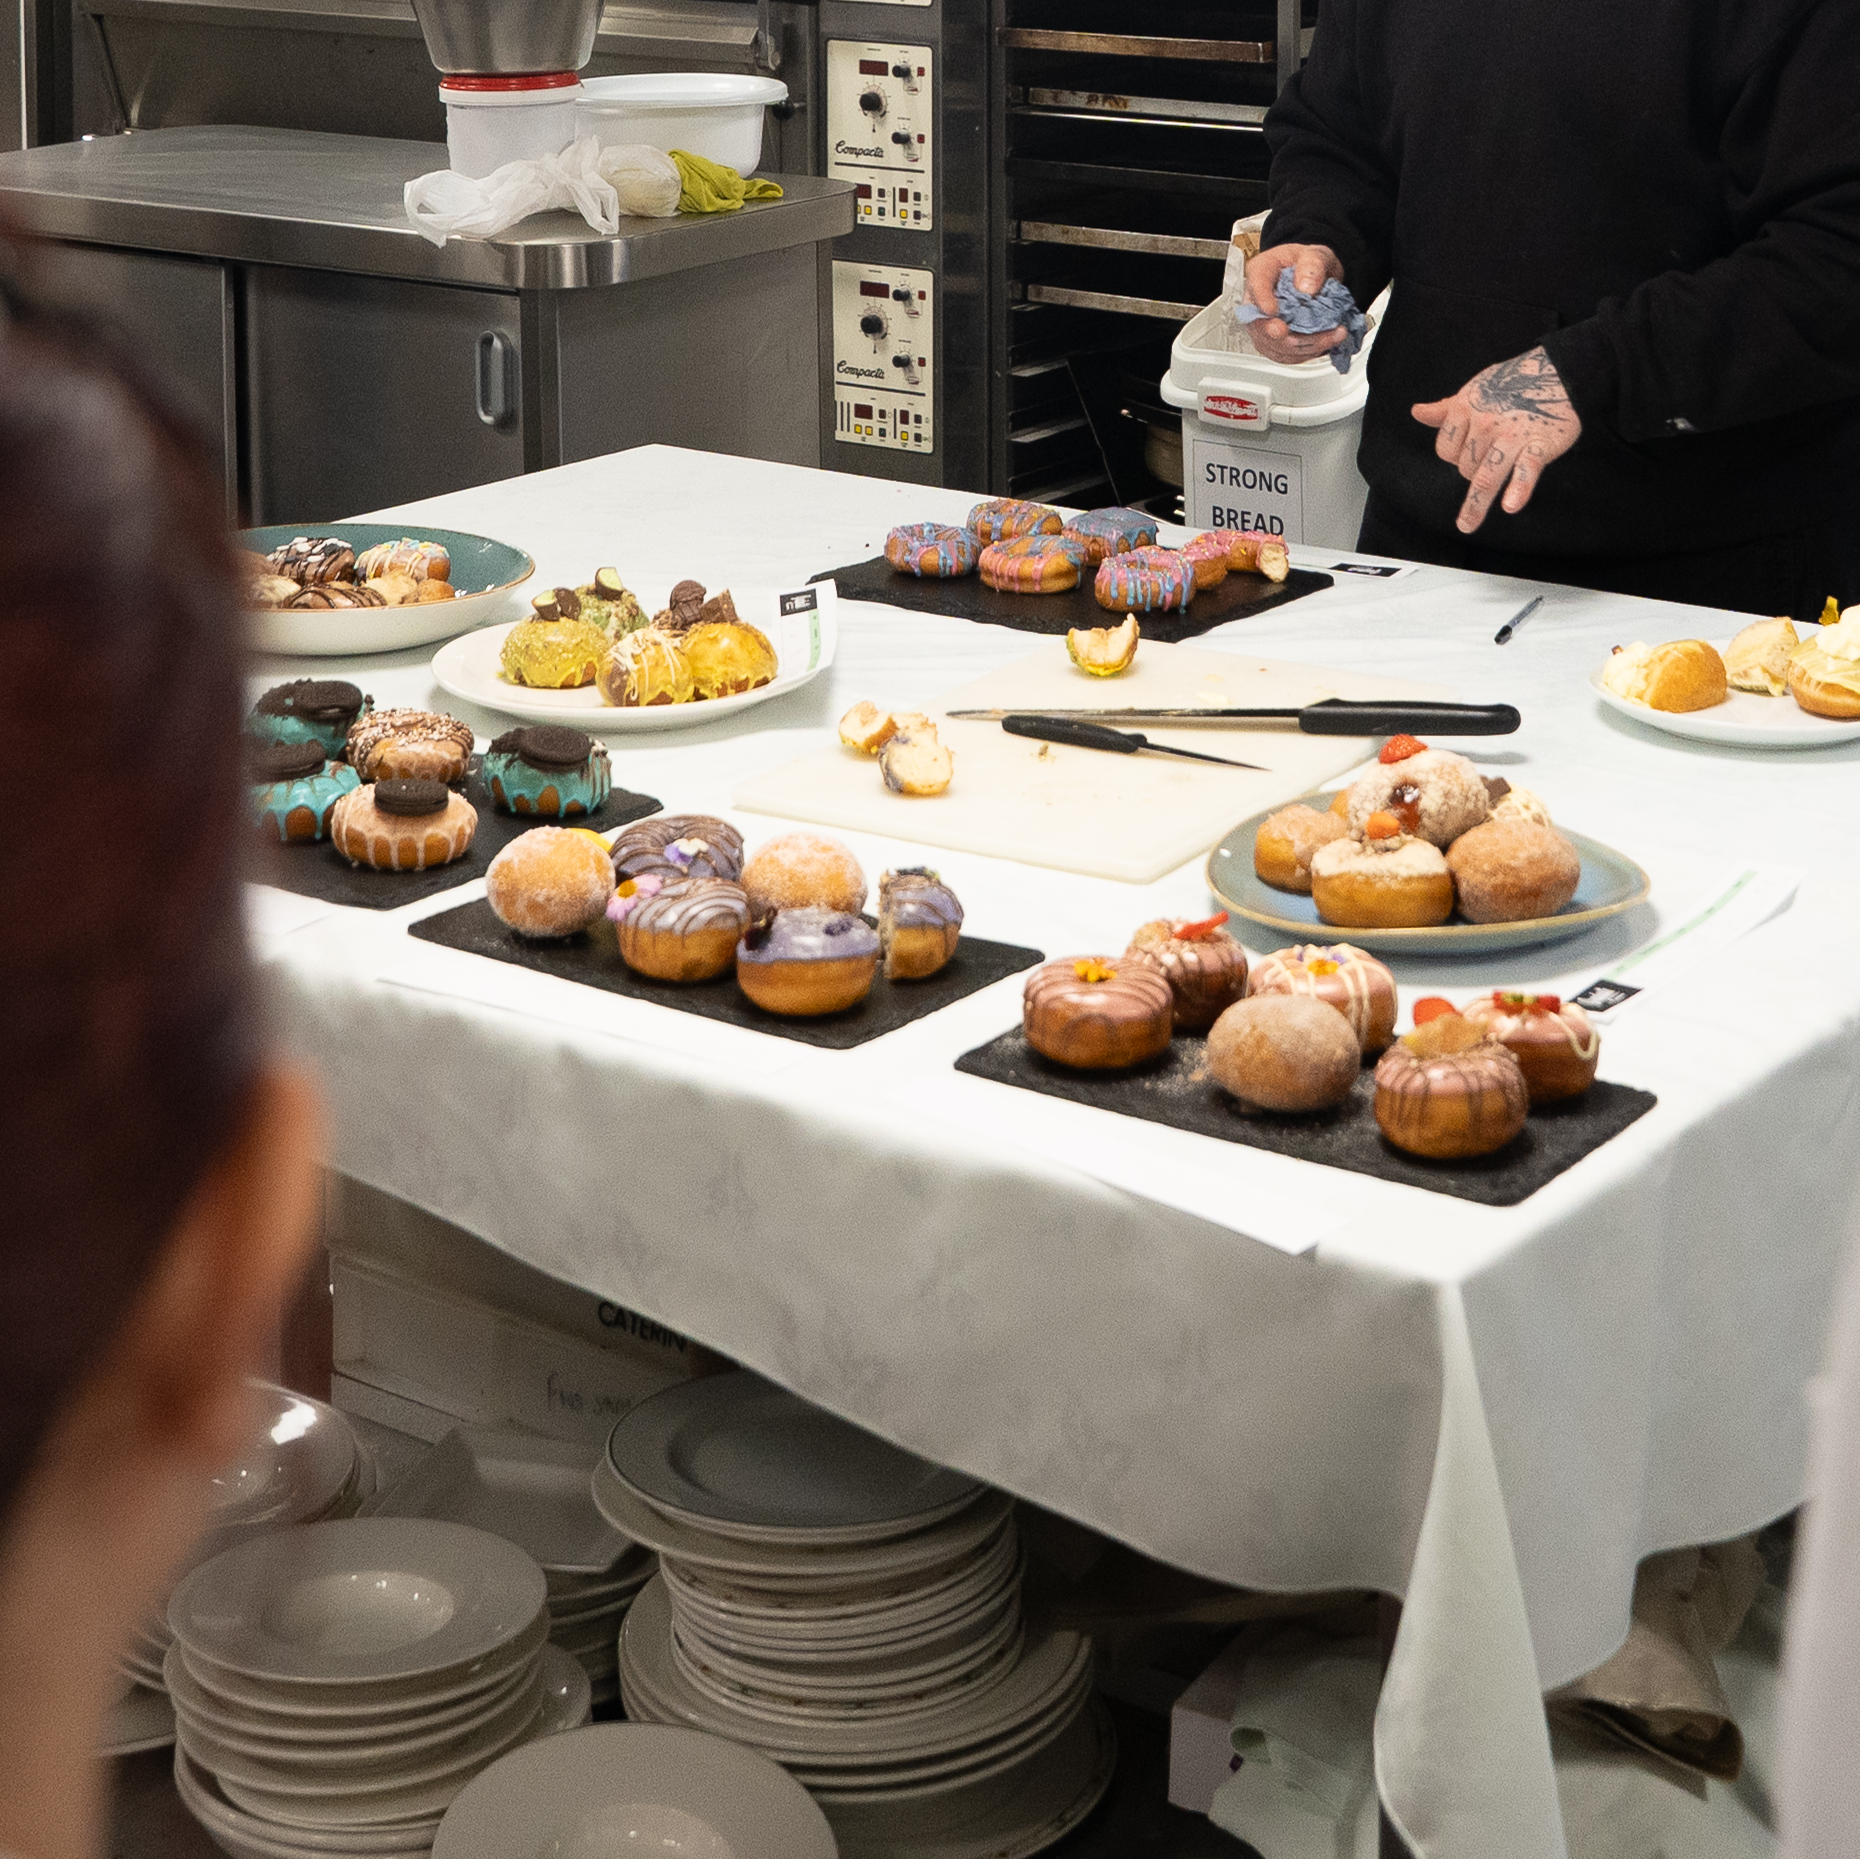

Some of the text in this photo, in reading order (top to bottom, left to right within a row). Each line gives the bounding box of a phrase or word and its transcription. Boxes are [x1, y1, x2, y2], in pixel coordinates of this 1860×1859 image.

[835, 140, 884, 158] Compacta
[836, 360, 885, 380] Compacta
[1205, 462, 1289, 495] STRONG
[1212, 505, 1285, 536] BREAD
